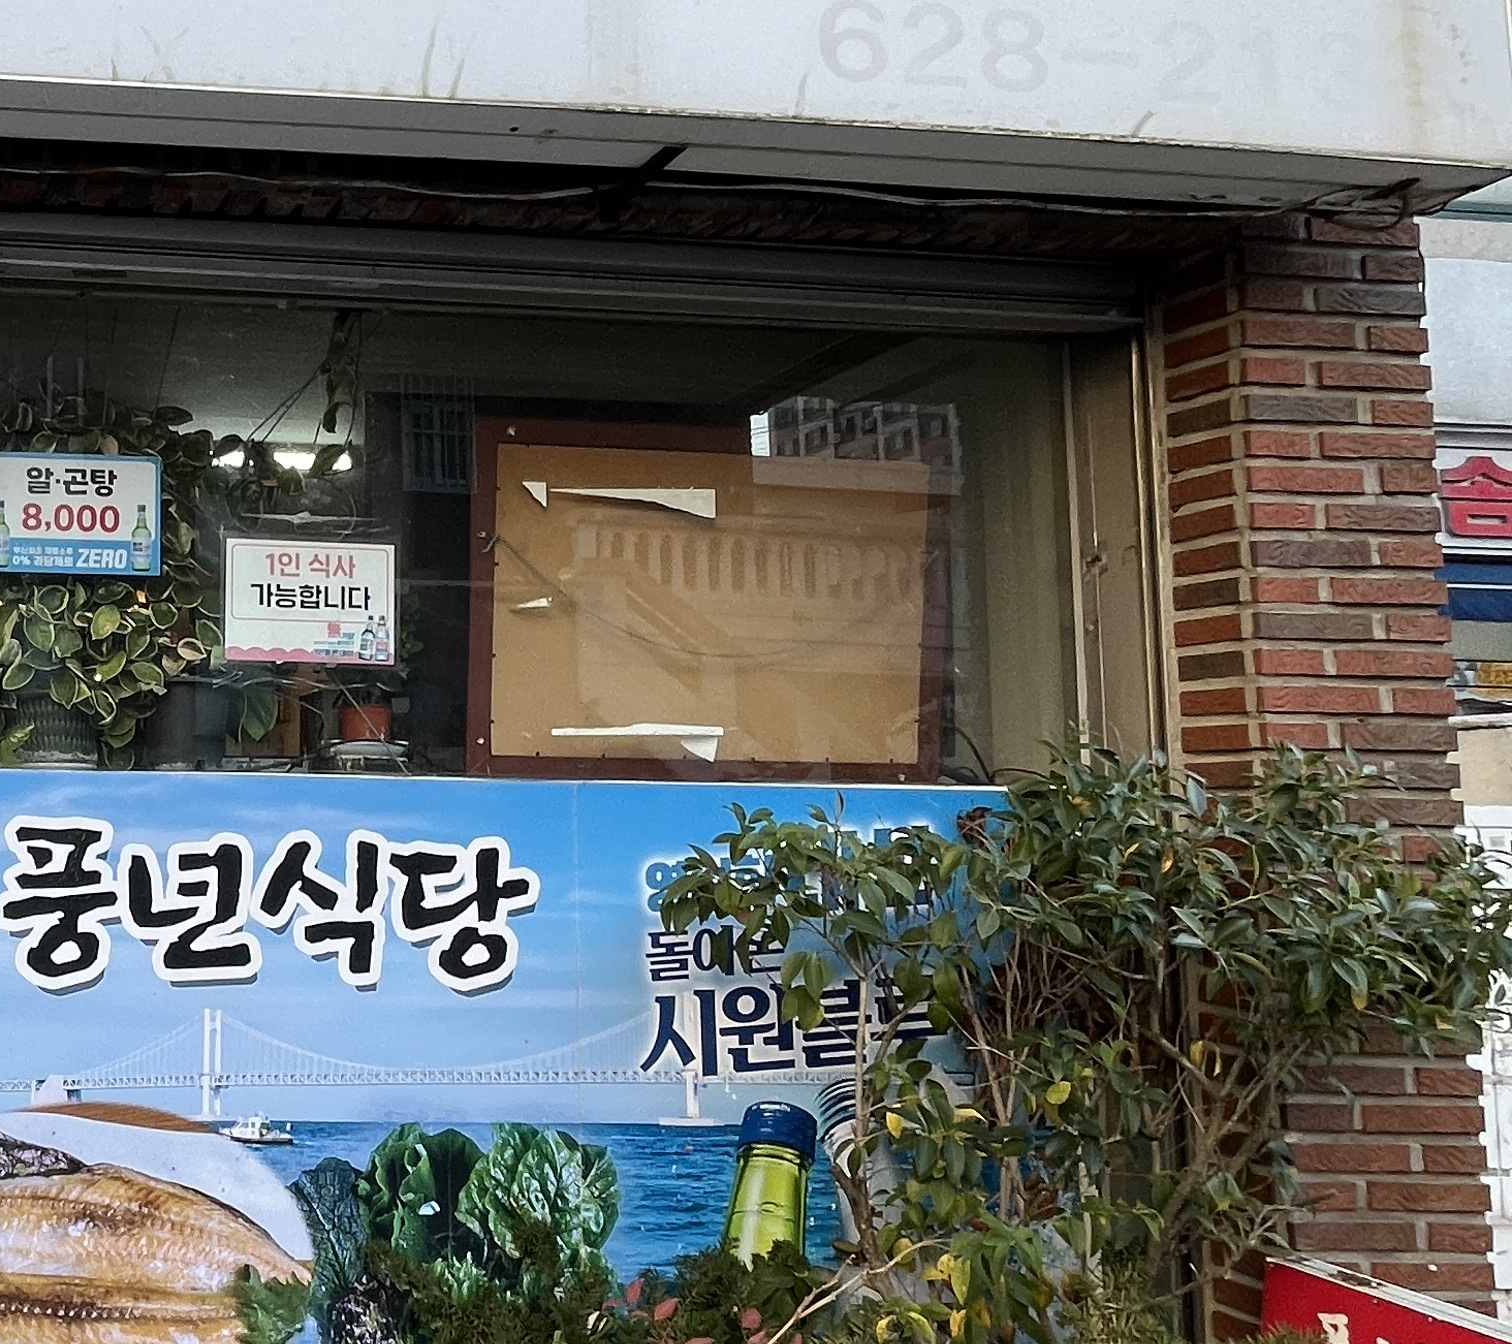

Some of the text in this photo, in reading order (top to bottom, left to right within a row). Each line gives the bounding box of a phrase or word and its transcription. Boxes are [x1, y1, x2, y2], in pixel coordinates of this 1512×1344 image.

[22, 502, 120, 534] 8,000
[12, 556, 31, 566] 0%
[76, 548, 128, 569] ZERO
[265, 552, 356, 579] 1인 식사
[250, 583, 371, 610] 가능합니다
